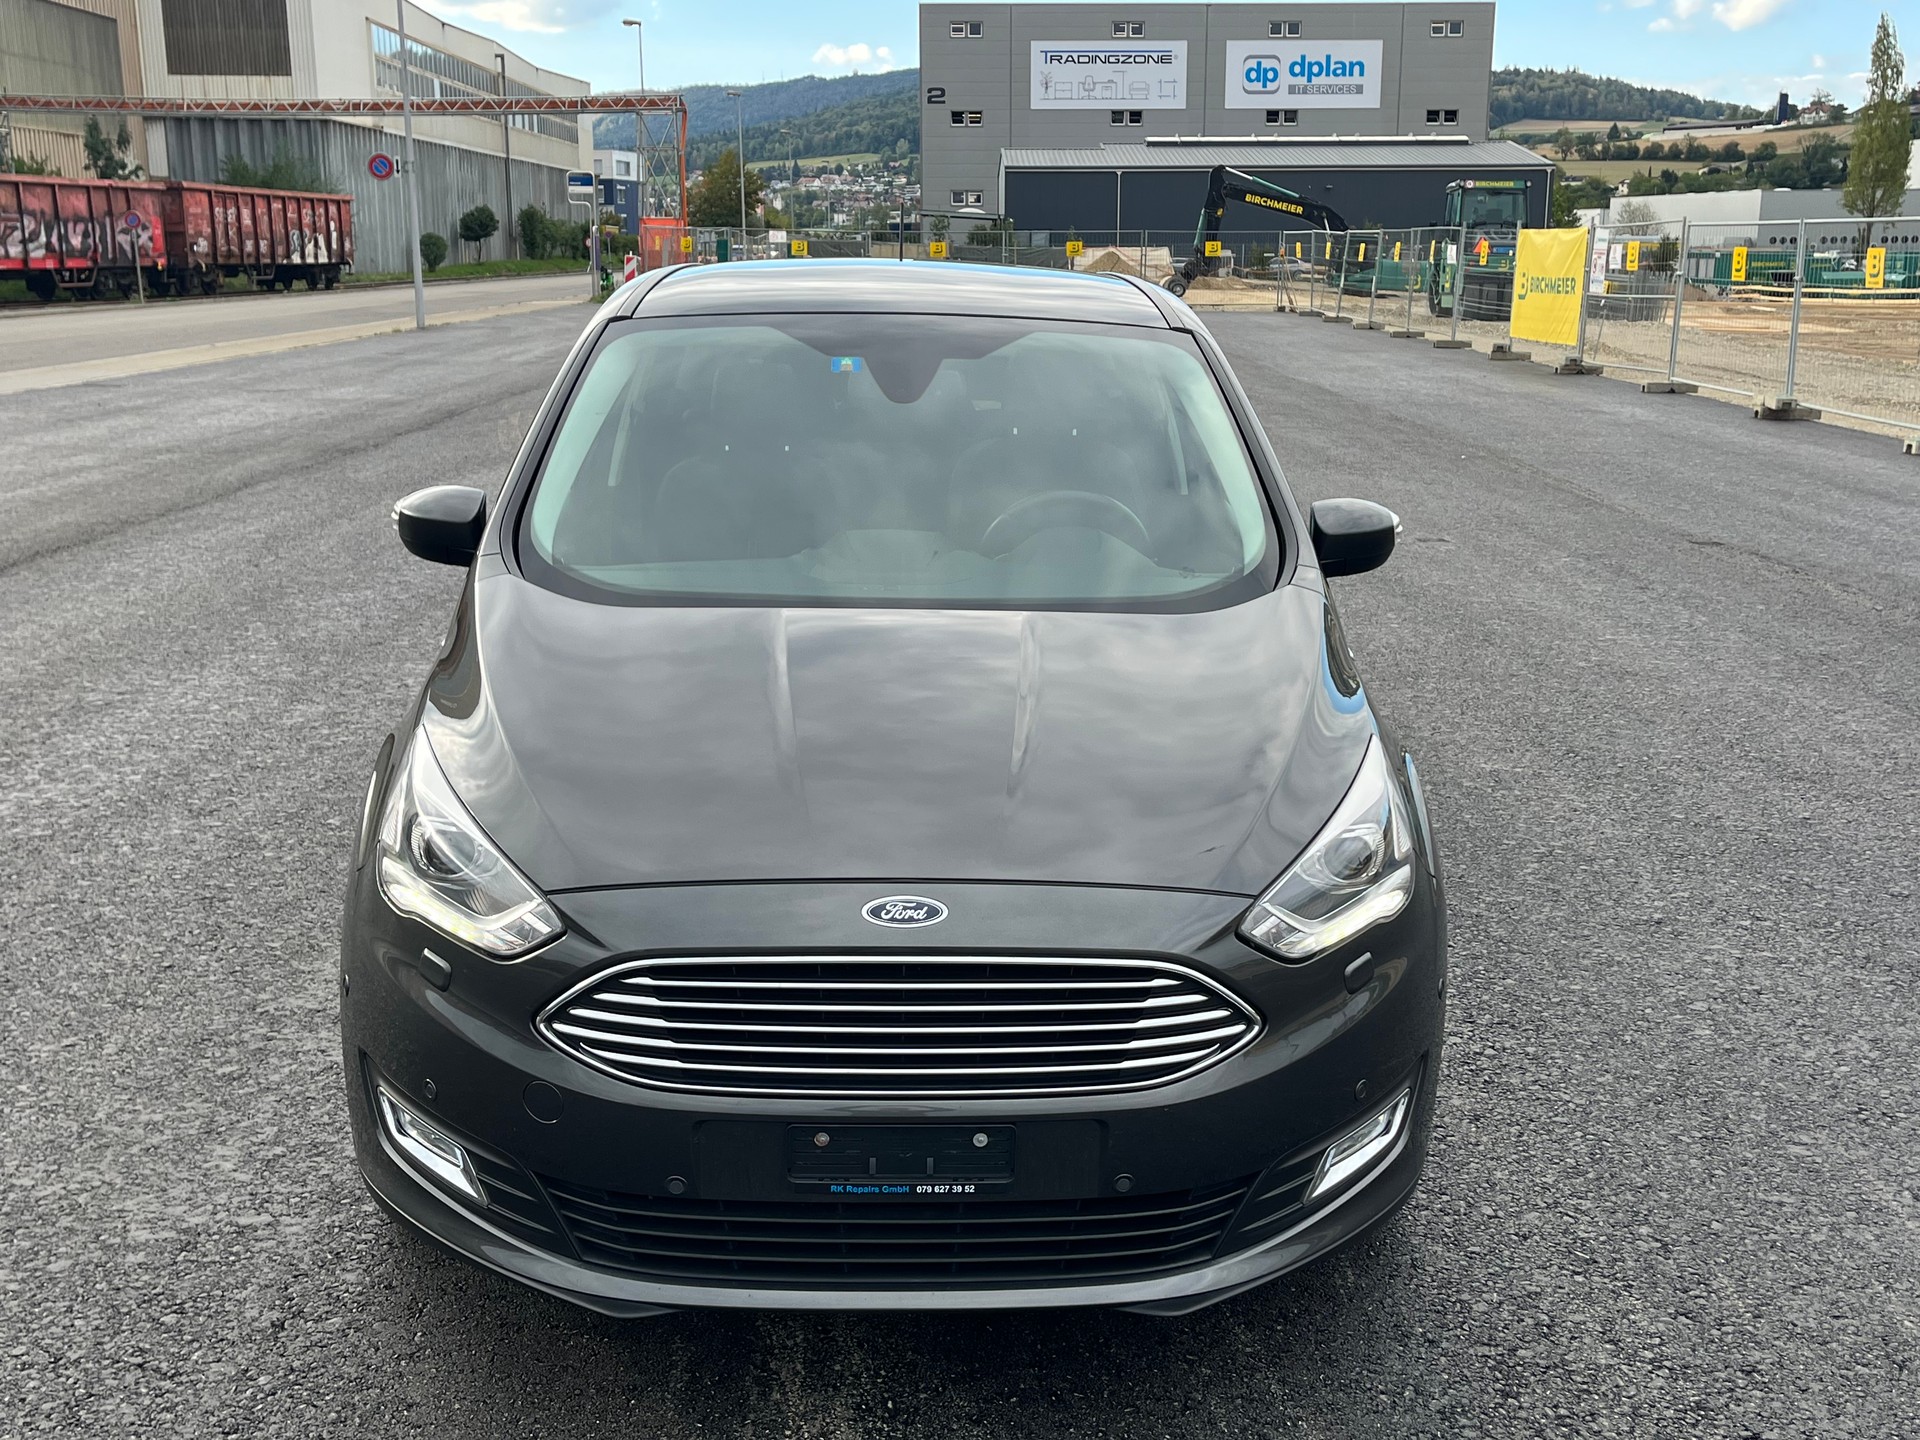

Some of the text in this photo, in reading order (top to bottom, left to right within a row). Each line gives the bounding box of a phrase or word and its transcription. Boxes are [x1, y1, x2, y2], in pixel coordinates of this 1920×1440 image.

[1040, 50, 1173, 65] TRADINGZONE
[1245, 60, 1279, 88] dp
[1288, 54, 1365, 83] dplan
[927, 87, 946, 104] 2
[1295, 85, 1357, 94] IT SERVICES
[1245, 193, 1304, 215] BIRCHMEIER
[1530, 276, 1577, 295] BIRCHMEIER
[880, 901, 929, 920] Ford
[830, 1185, 976, 1194] RK Repairs GmbH 079 627 39 52
